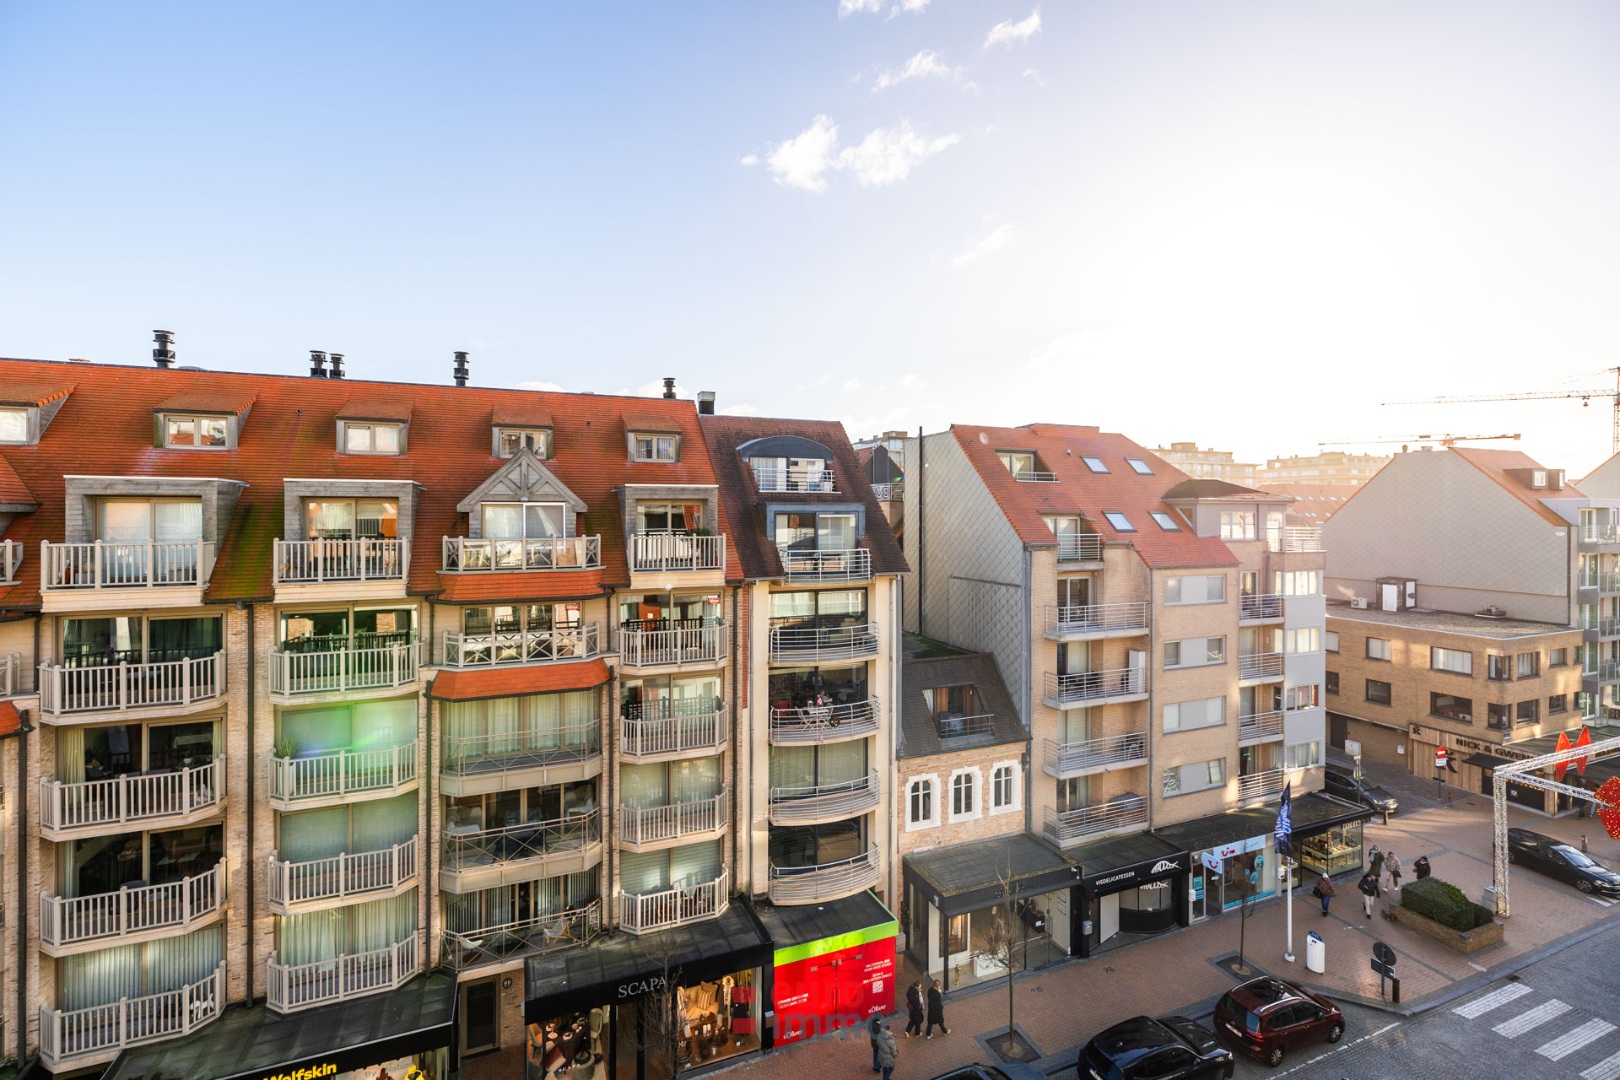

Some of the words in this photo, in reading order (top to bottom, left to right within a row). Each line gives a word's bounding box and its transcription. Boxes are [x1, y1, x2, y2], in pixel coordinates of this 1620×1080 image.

[1455, 737, 1482, 751] NICK
[1484, 745, 1492, 754] &
[1495, 747, 1534, 760] GWEN
[1095, 871, 1135, 886] VISDELICATESSEN
[618, 976, 667, 998] SCAPA
